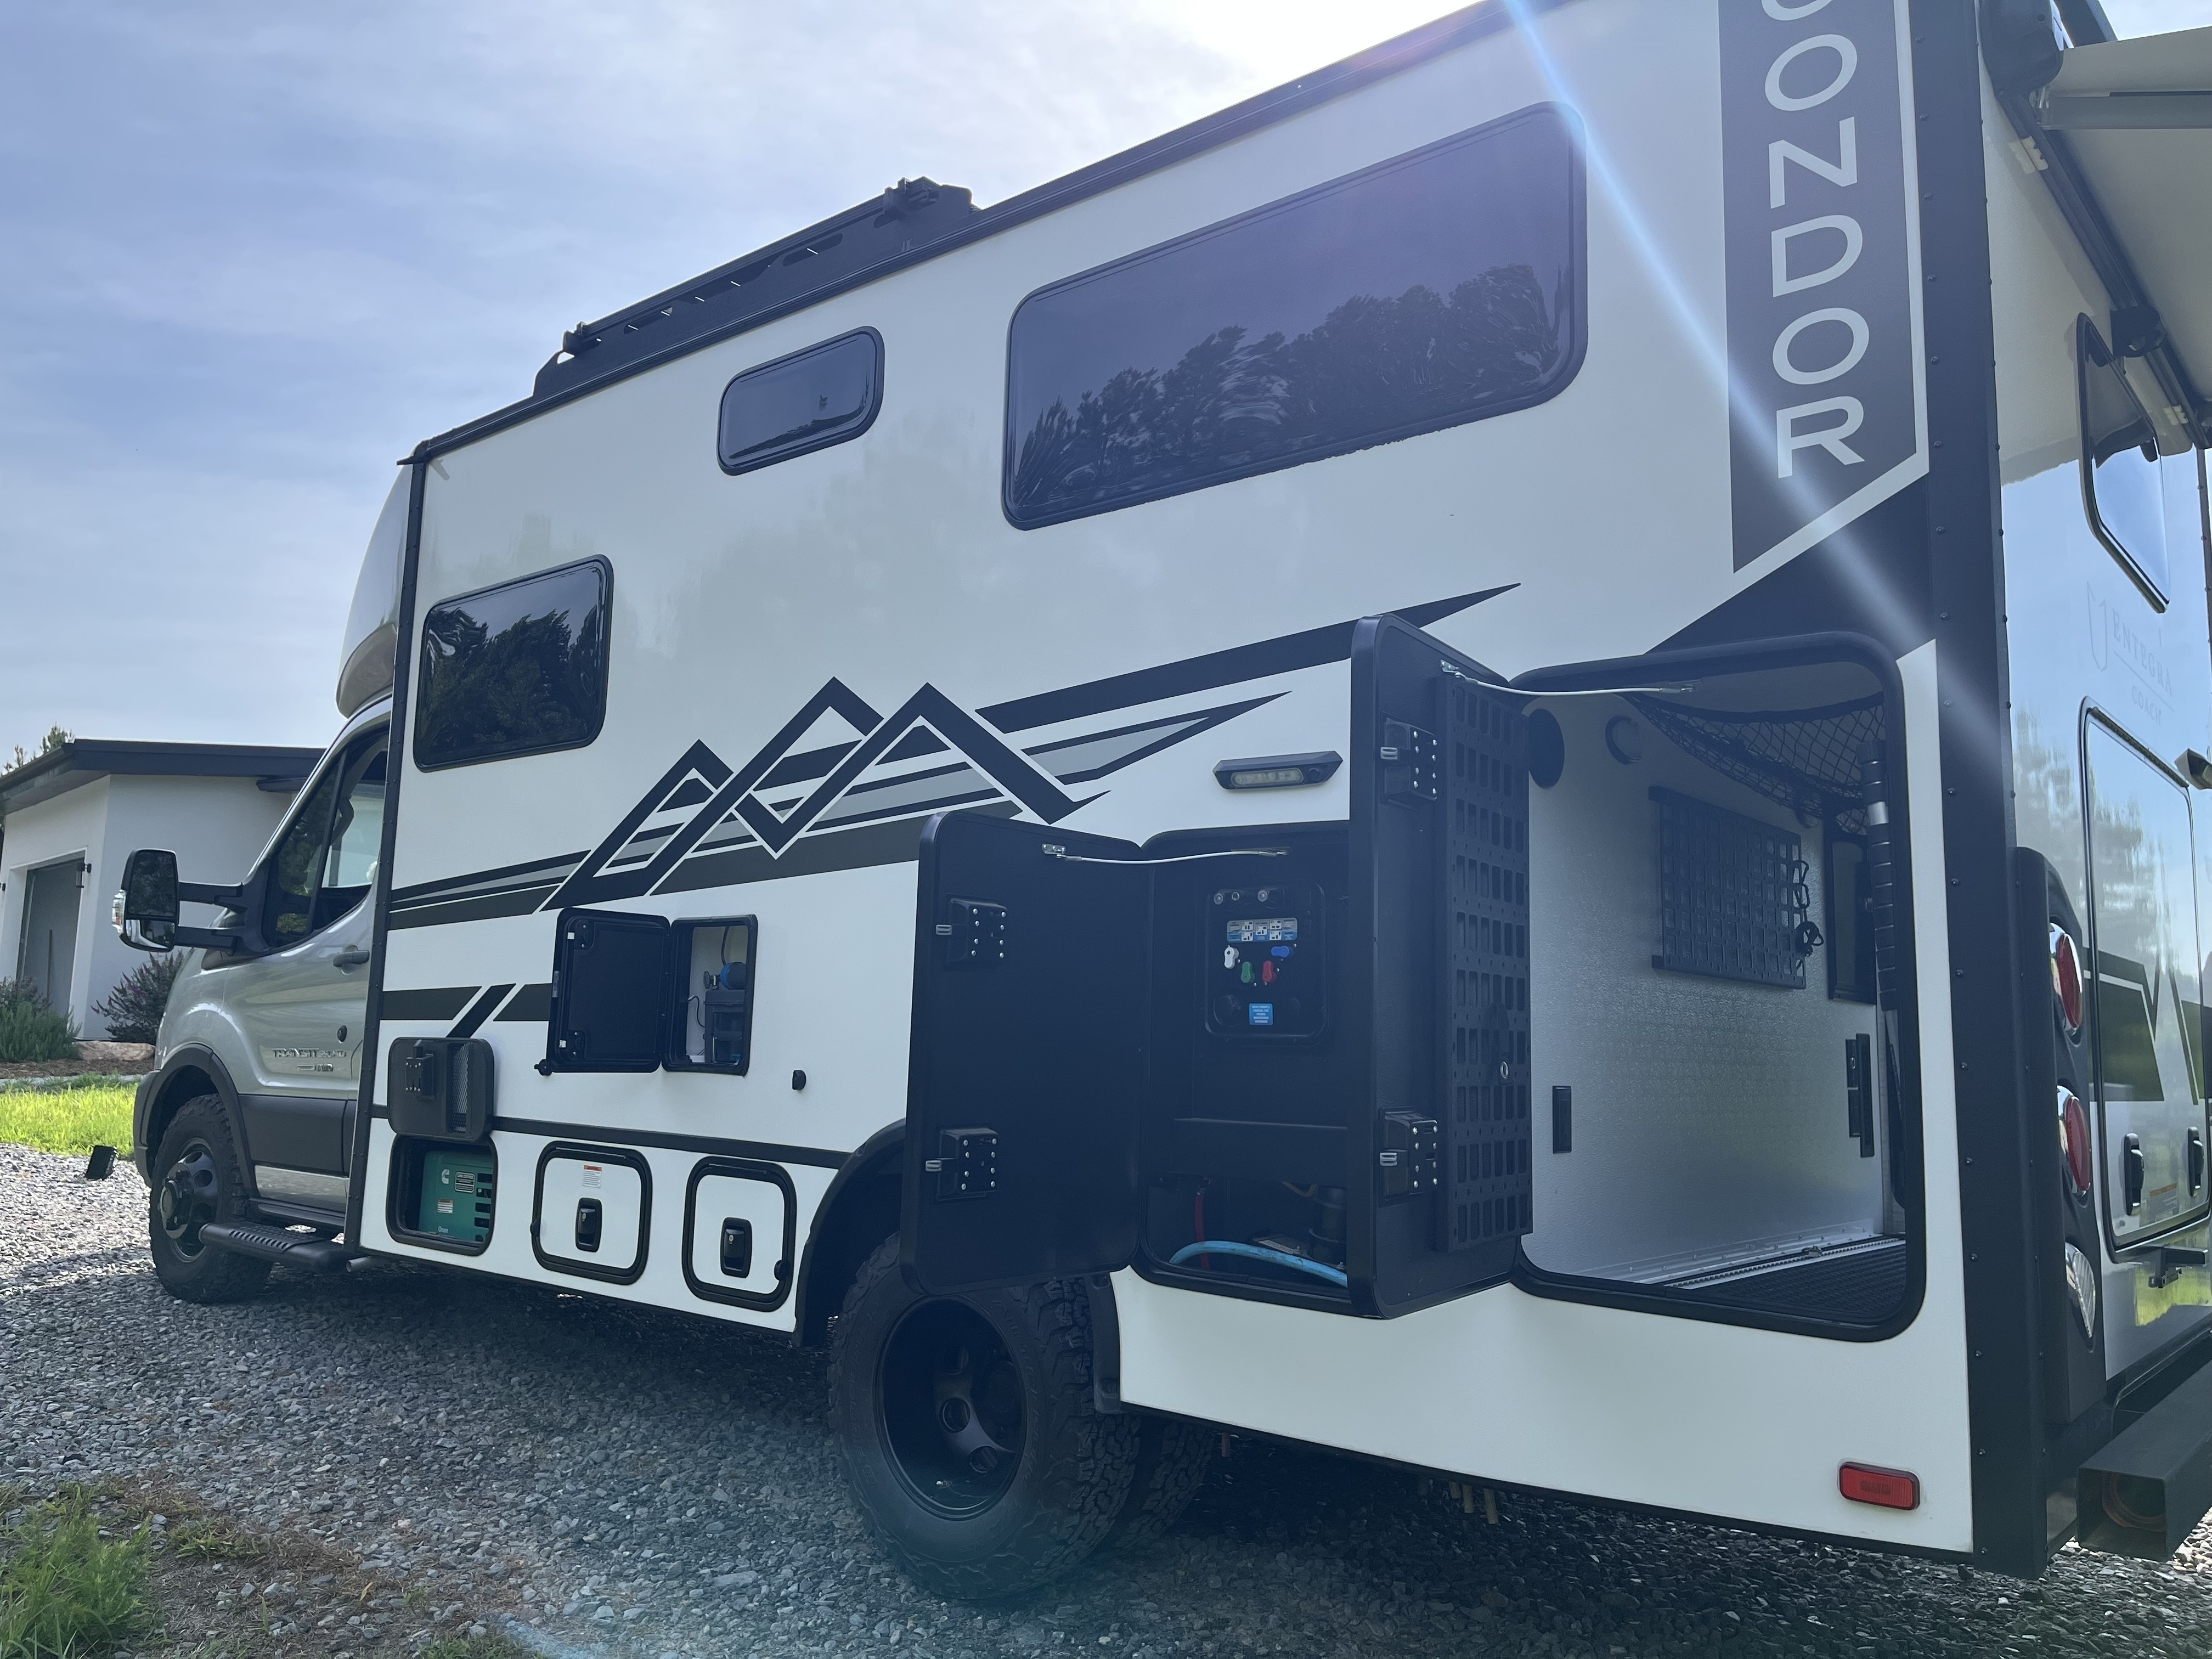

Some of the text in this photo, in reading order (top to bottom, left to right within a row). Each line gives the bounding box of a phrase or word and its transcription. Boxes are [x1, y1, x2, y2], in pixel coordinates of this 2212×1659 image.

[1761, 0, 1869, 478] ONDOR
[2112, 607, 2173, 697] ENTEGRA
[2131, 685, 2162, 725] COACH
